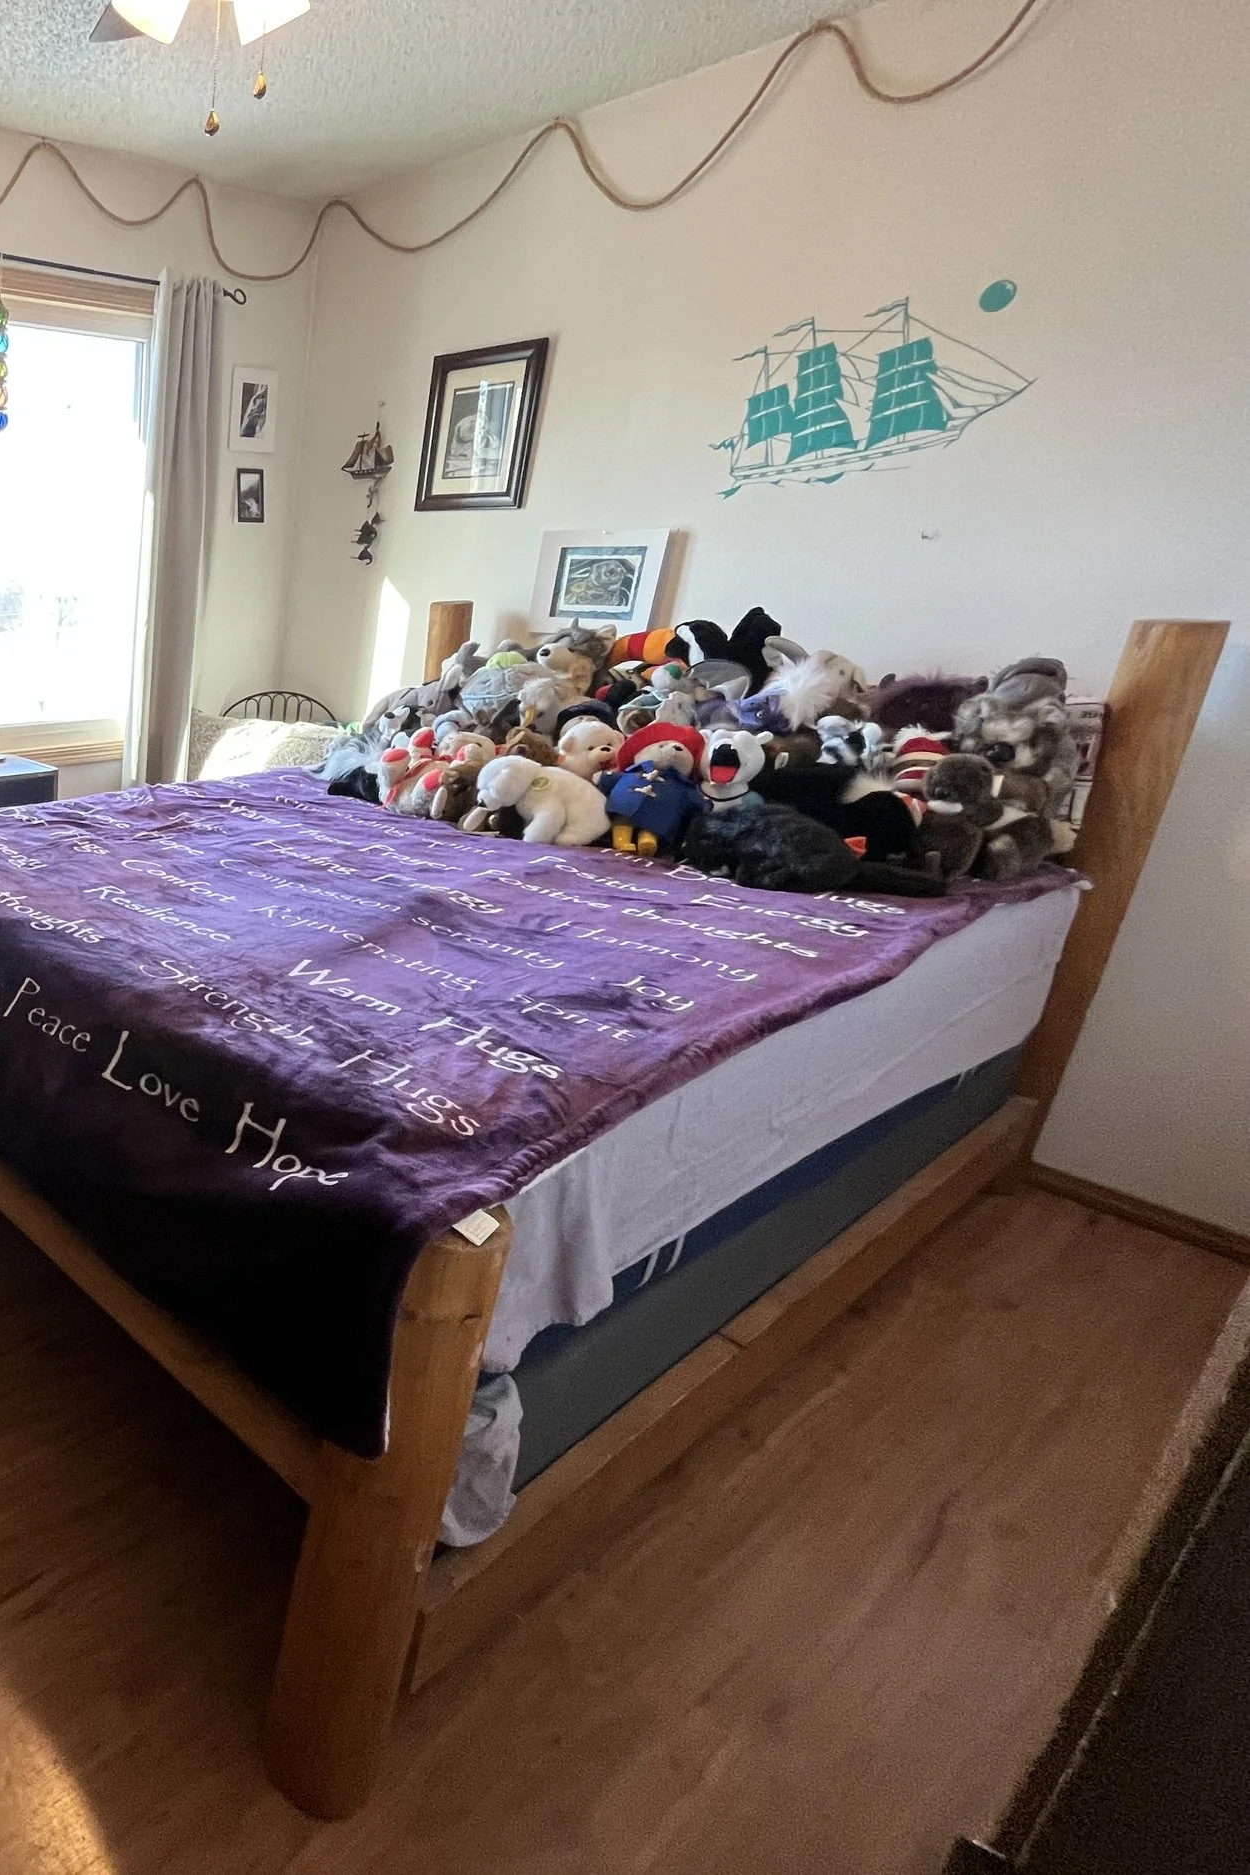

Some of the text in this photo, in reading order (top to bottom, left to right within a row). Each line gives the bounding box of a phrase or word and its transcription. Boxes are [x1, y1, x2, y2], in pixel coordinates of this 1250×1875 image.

[121, 859, 237, 902] Comfort
[358, 844, 463, 871] Prayer
[470, 868, 612, 910] Positive
[622, 906, 820, 959] thoughts
[371, 873, 503, 914] Energy
[546, 920, 759, 983] Harmony
[528, 854, 669, 896] Positive
[690, 893, 870, 937] Energy
[814, 892, 906, 914] ugs
[84, 884, 232, 943] Resilience
[288, 959, 403, 1017] Warm
[418, 1015, 565, 1080] Hugs
[2, 977, 91, 1052] Peace
[101, 1030, 200, 1122] Love
[225, 1102, 349, 1191] Hope
[139, 959, 314, 1046] Strength
[336, 1049, 482, 1137] Hugs
